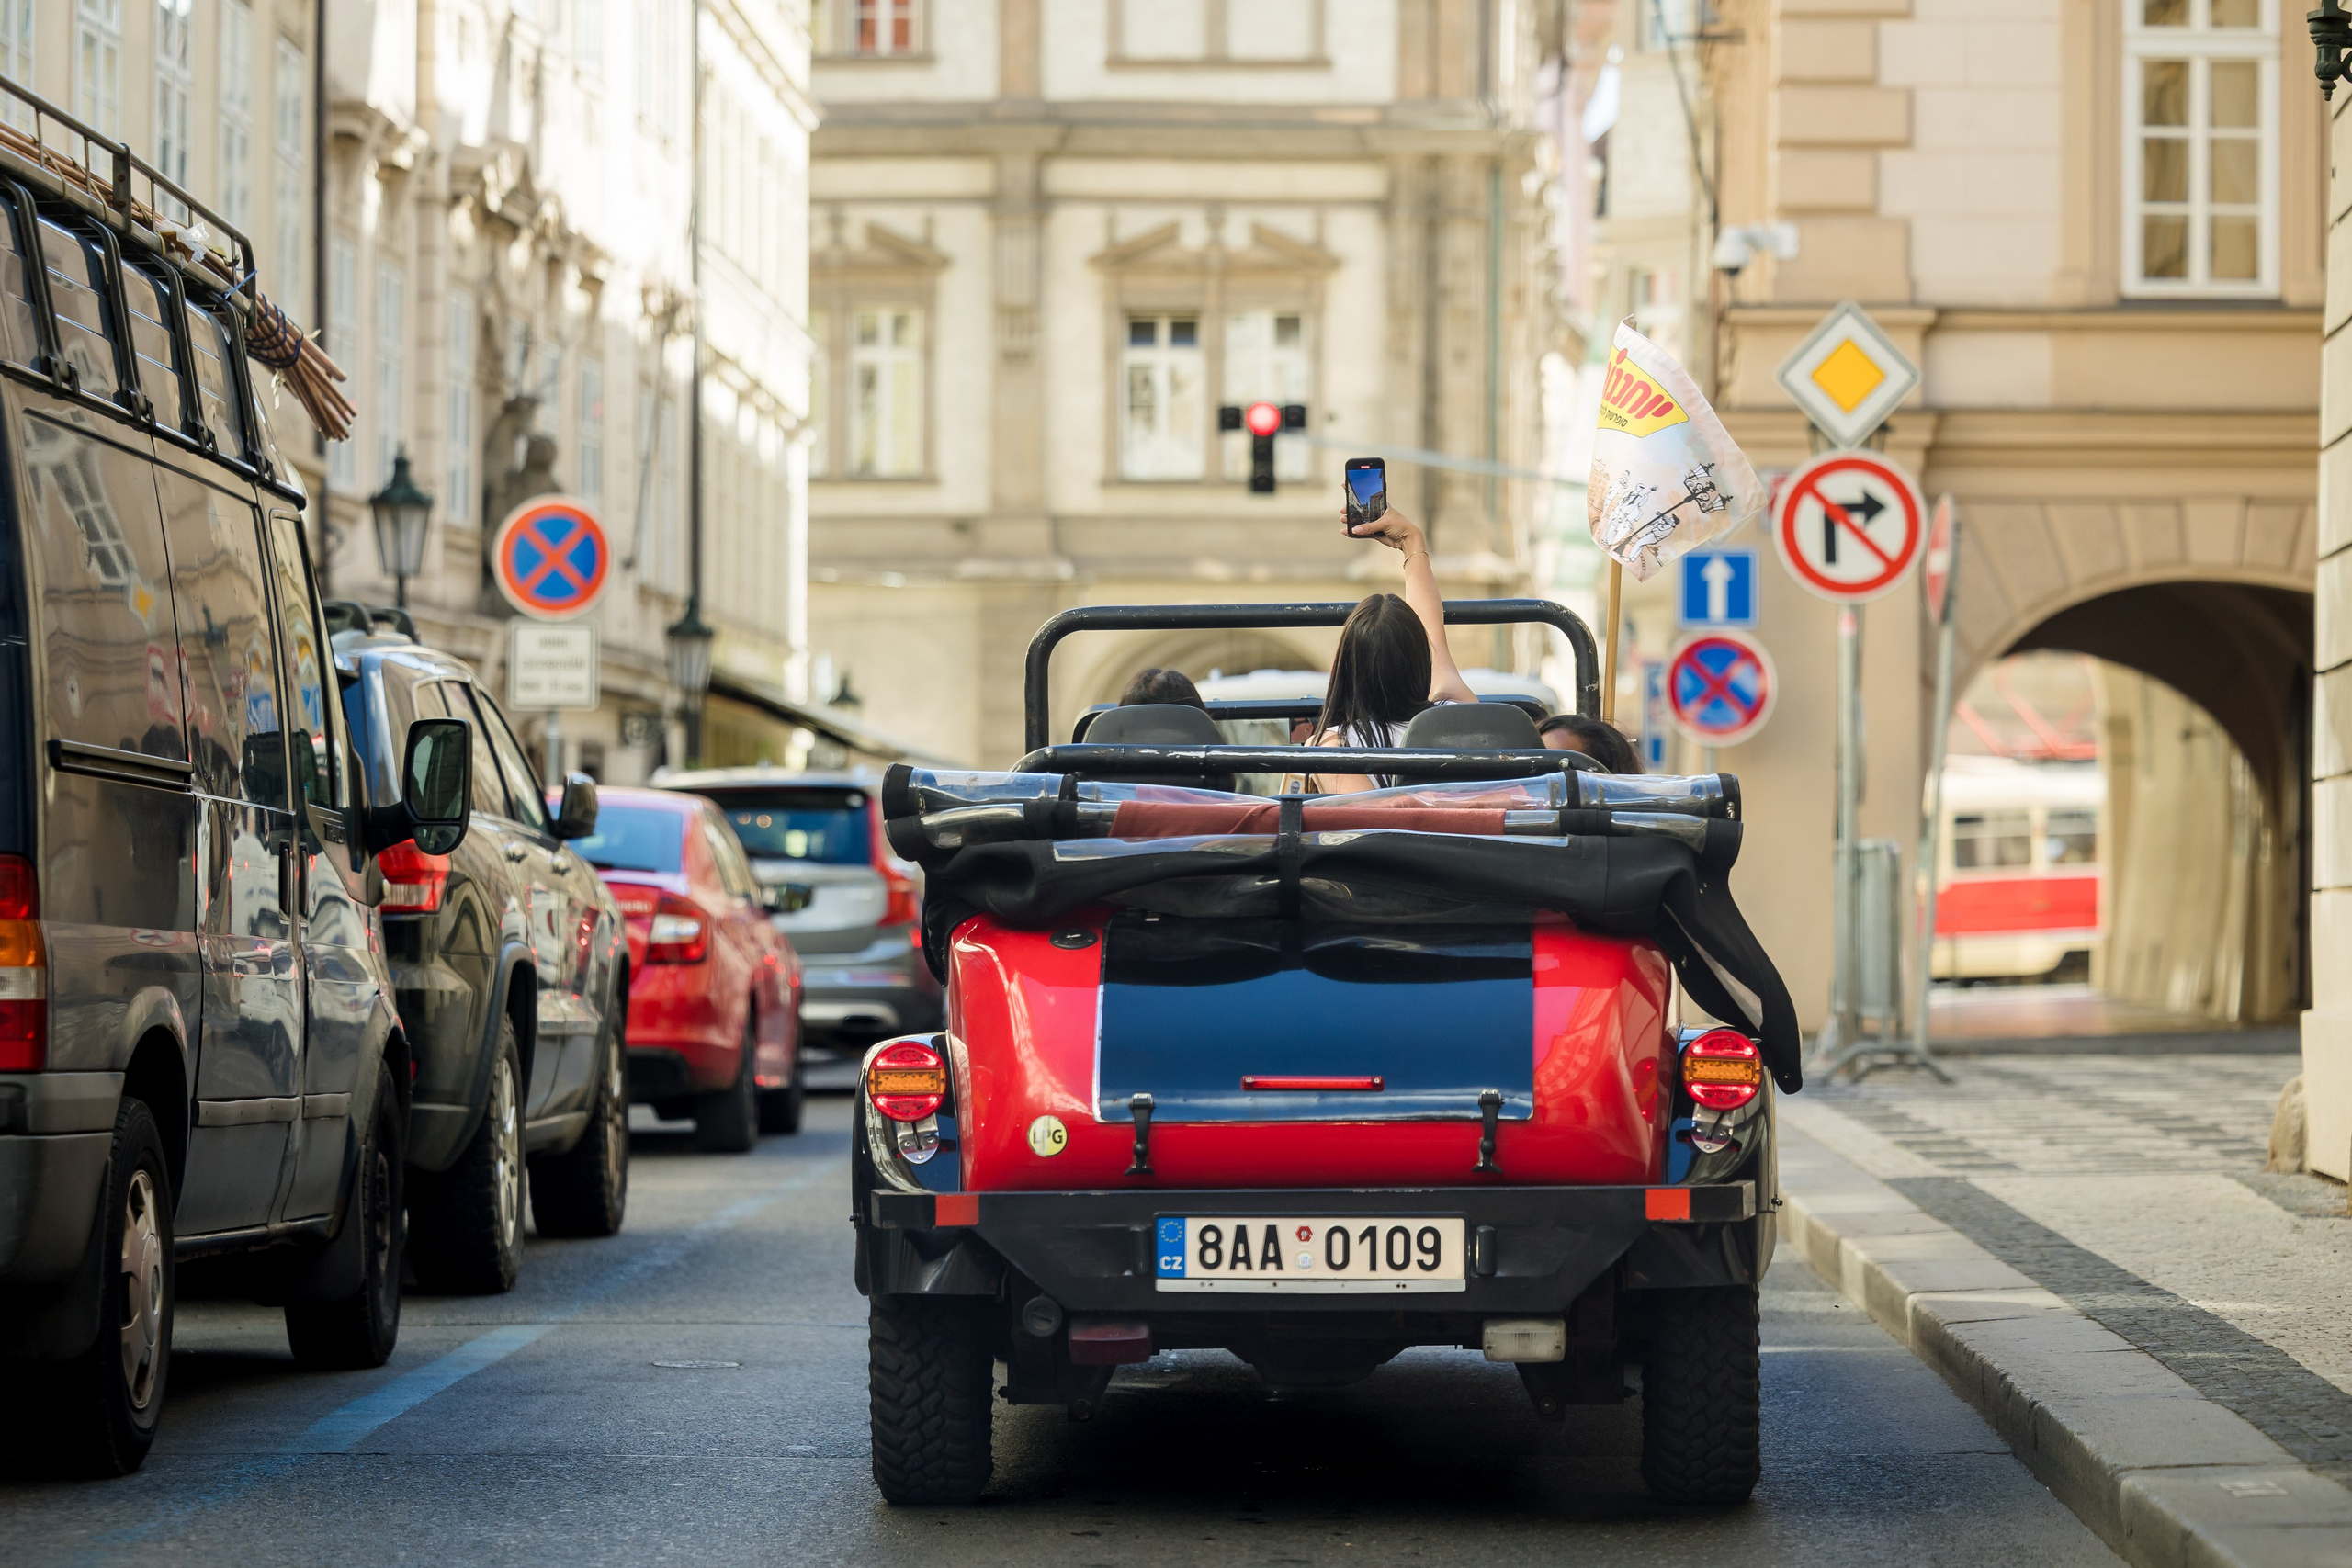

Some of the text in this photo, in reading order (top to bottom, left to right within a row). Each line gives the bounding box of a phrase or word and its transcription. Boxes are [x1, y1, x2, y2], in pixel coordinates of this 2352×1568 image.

[1602, 348, 1674, 420] יוחננו
[1033, 1129, 1063, 1145] LPG
[1159, 1256, 1183, 1270] CZ
[1198, 1224, 1442, 1272] 8AA 0109
